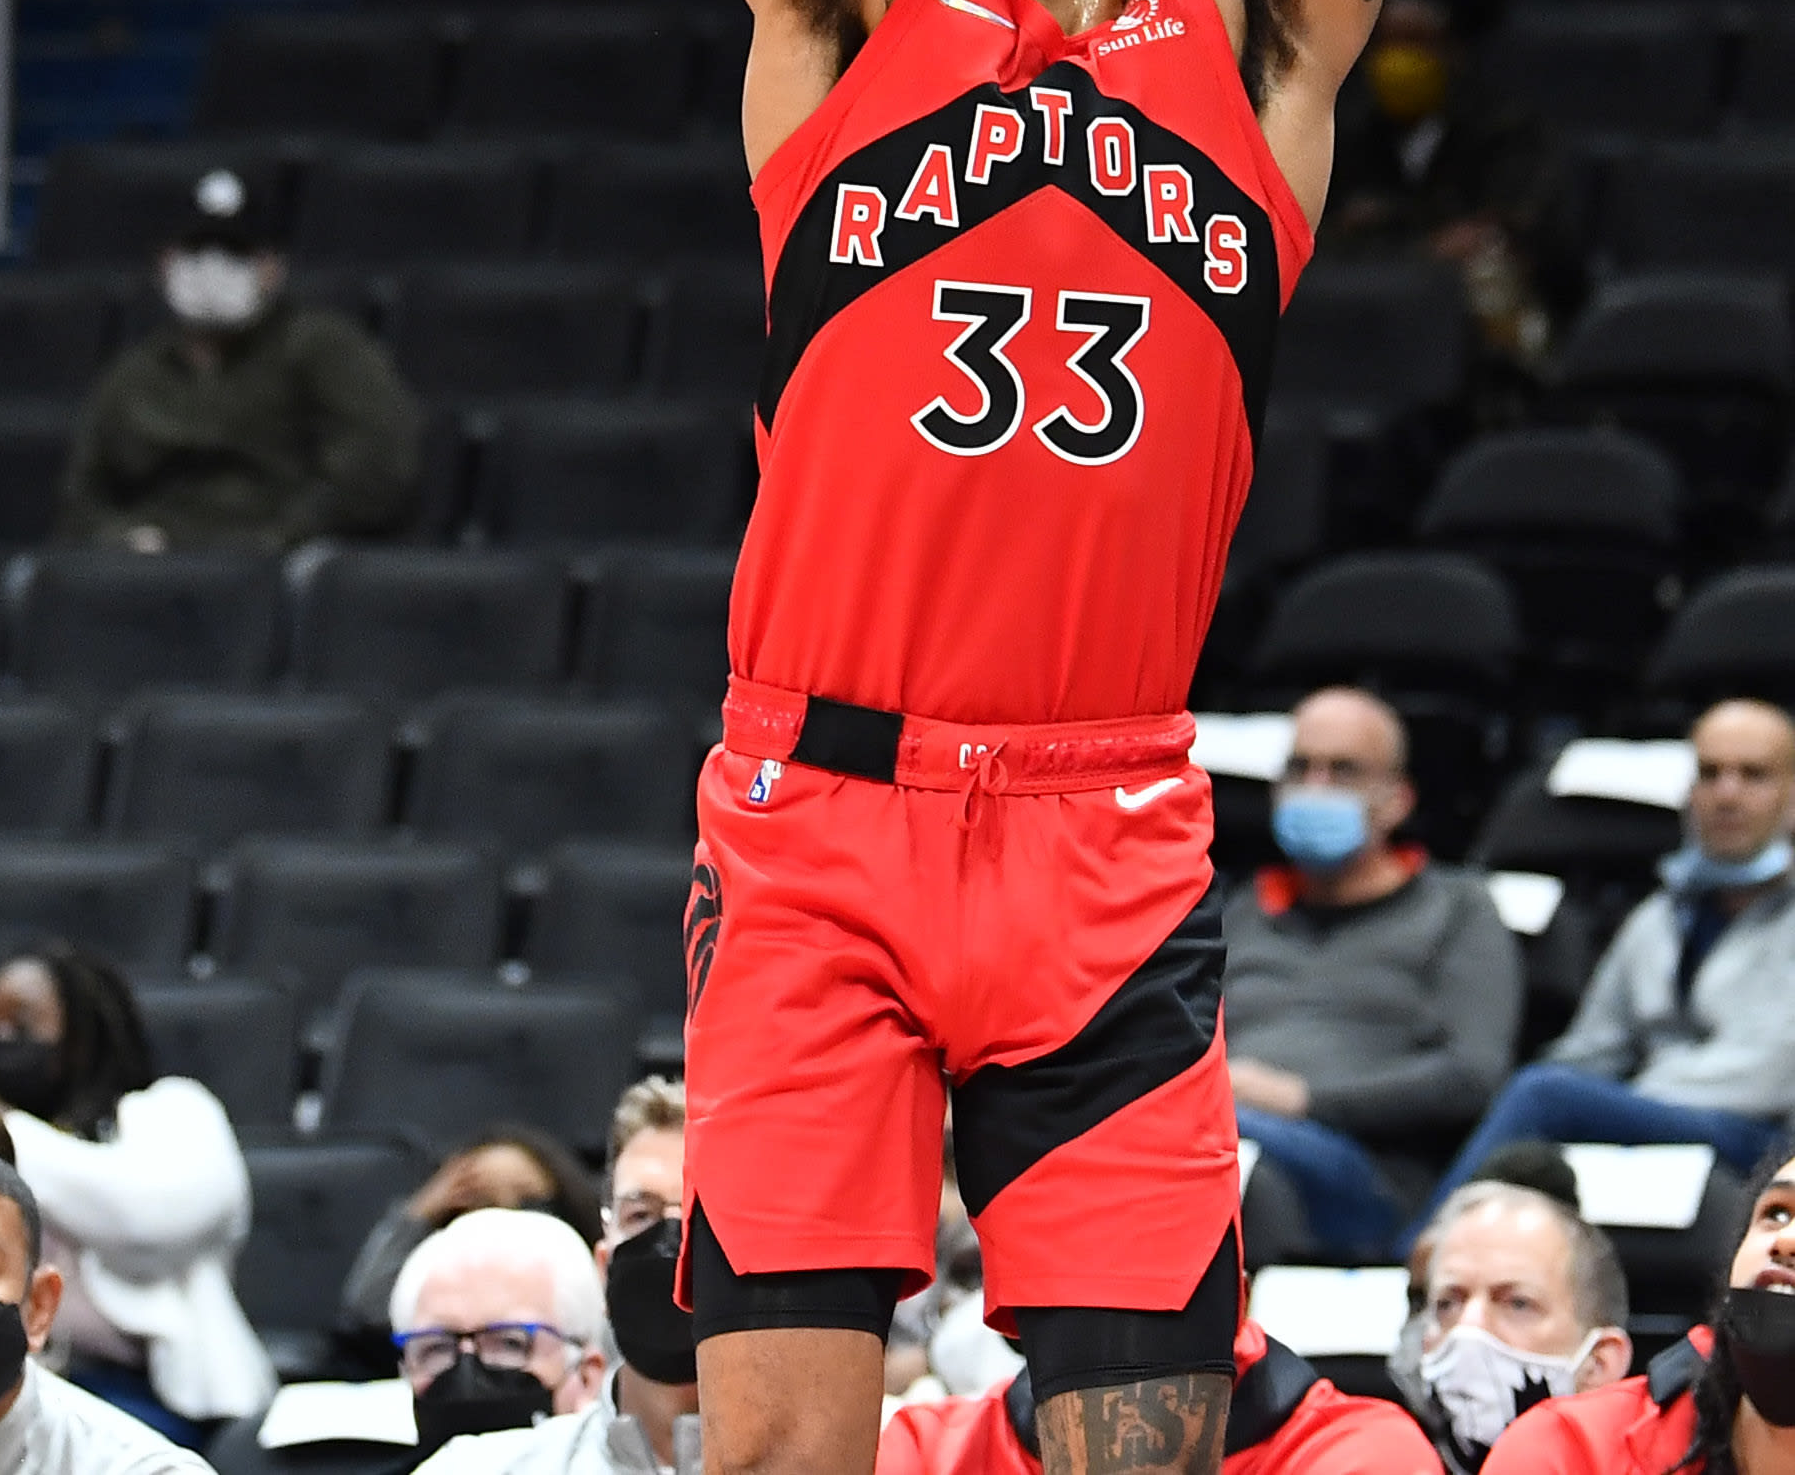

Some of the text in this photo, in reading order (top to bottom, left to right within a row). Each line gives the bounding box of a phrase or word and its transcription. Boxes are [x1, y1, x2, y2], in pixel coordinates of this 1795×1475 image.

[1142, 16, 1186, 43] Life
[829, 86, 1248, 295] RAPTORS
[909, 279, 1153, 467] 33
